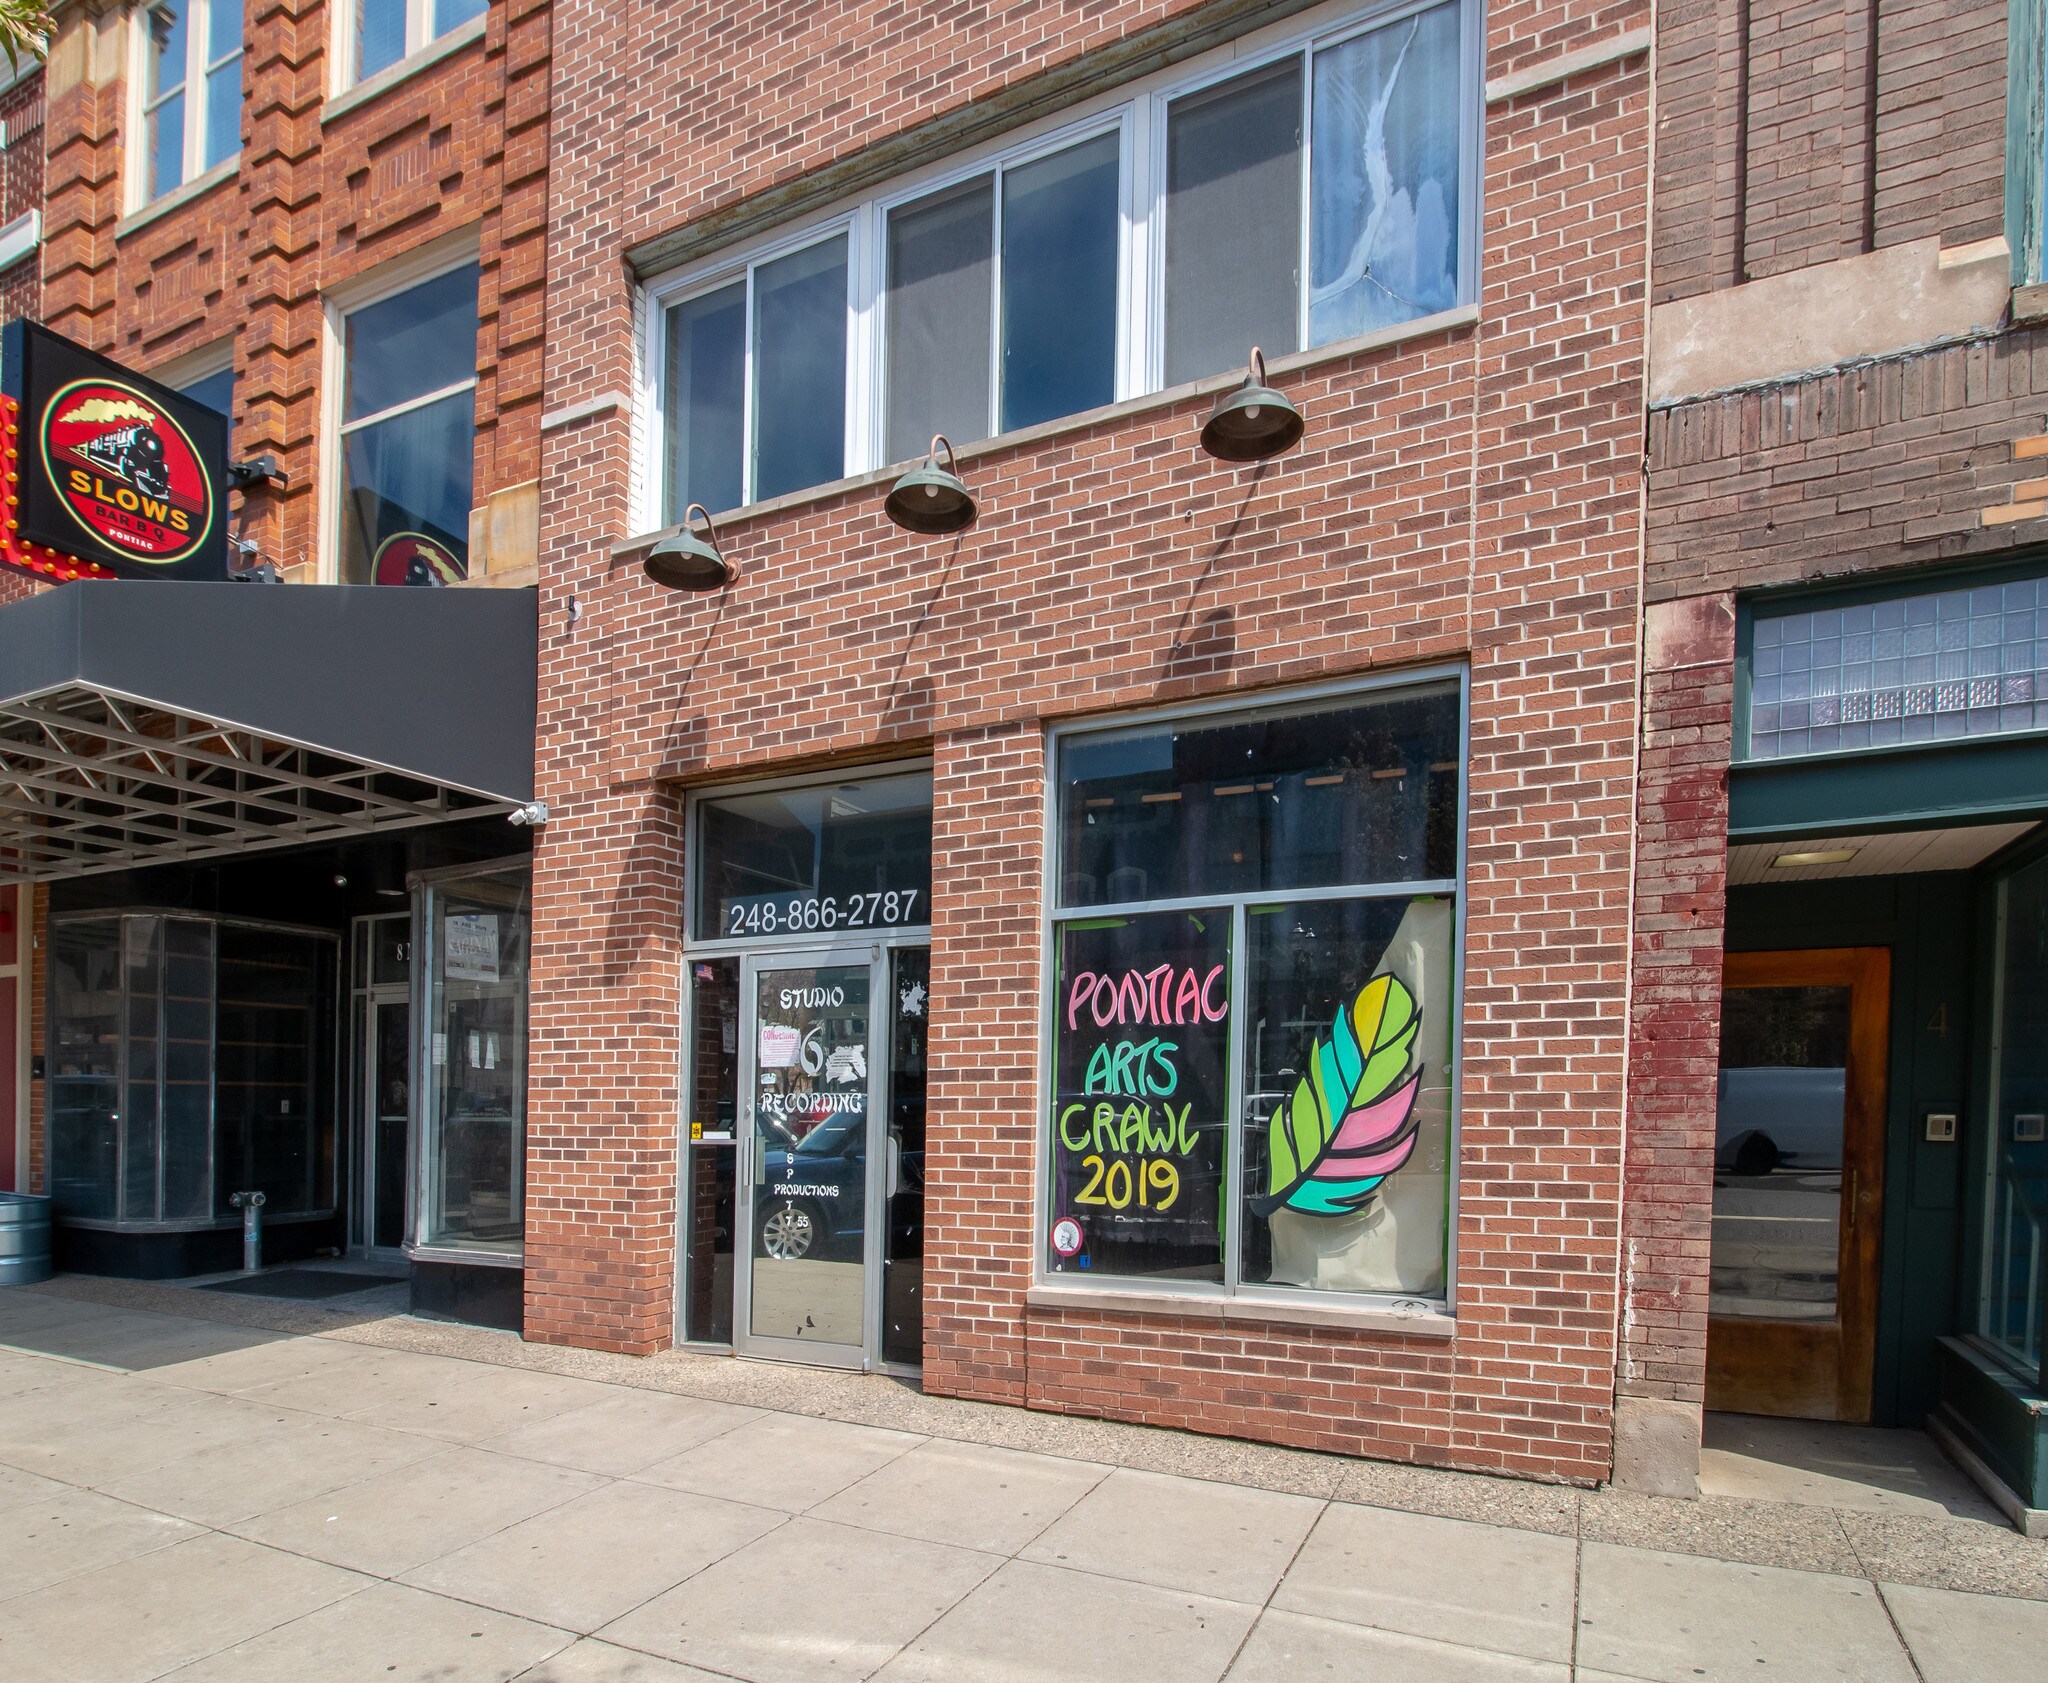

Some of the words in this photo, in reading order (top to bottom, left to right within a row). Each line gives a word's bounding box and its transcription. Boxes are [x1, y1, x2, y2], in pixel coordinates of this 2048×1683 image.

[69, 470, 189, 531] SLOWS
[96, 505, 130, 527] BAR
[136, 517, 148, 532] B
[153, 528, 165, 541] Q
[109, 528, 153, 550] PONTIAC
[730, 889, 918, 935] 248-866-2787
[780, 987, 844, 1010] STUDIO
[1068, 963, 1229, 1030] PONTIAC
[1085, 1036, 1179, 1096] ARTS
[760, 1092, 863, 1114] RECORDING
[1060, 1102, 1200, 1156] CRAWL
[774, 1184, 839, 1197] PRODUCTIONS
[1074, 1154, 1180, 1211] 2019
[797, 1215, 809, 1228] 55
